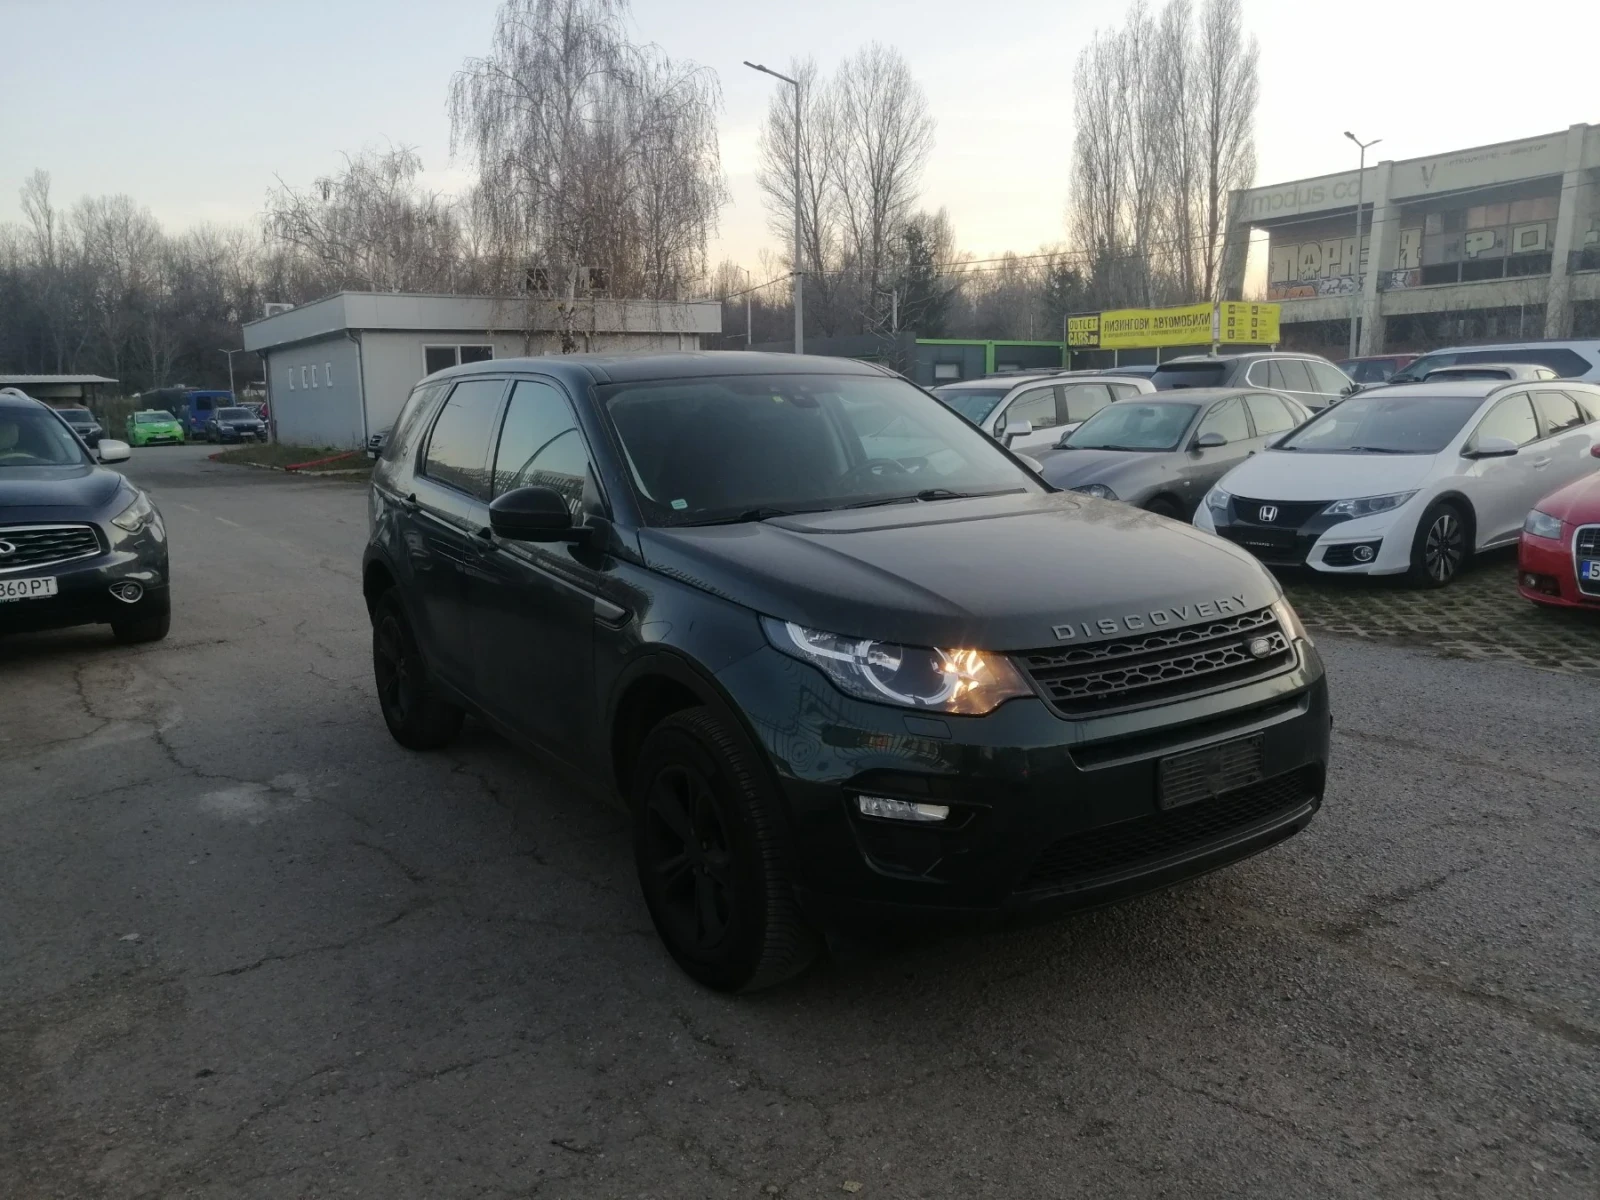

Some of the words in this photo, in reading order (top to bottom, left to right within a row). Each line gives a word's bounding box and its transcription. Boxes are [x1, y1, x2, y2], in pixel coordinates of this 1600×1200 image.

[1069, 318, 1097, 330] OUTLET
[1104, 318, 1150, 333] ЛИЗИНГОВИ
[1153, 312, 1211, 329] АВТОМОБИЛИ
[1052, 594, 1249, 640] DISCOVERY
